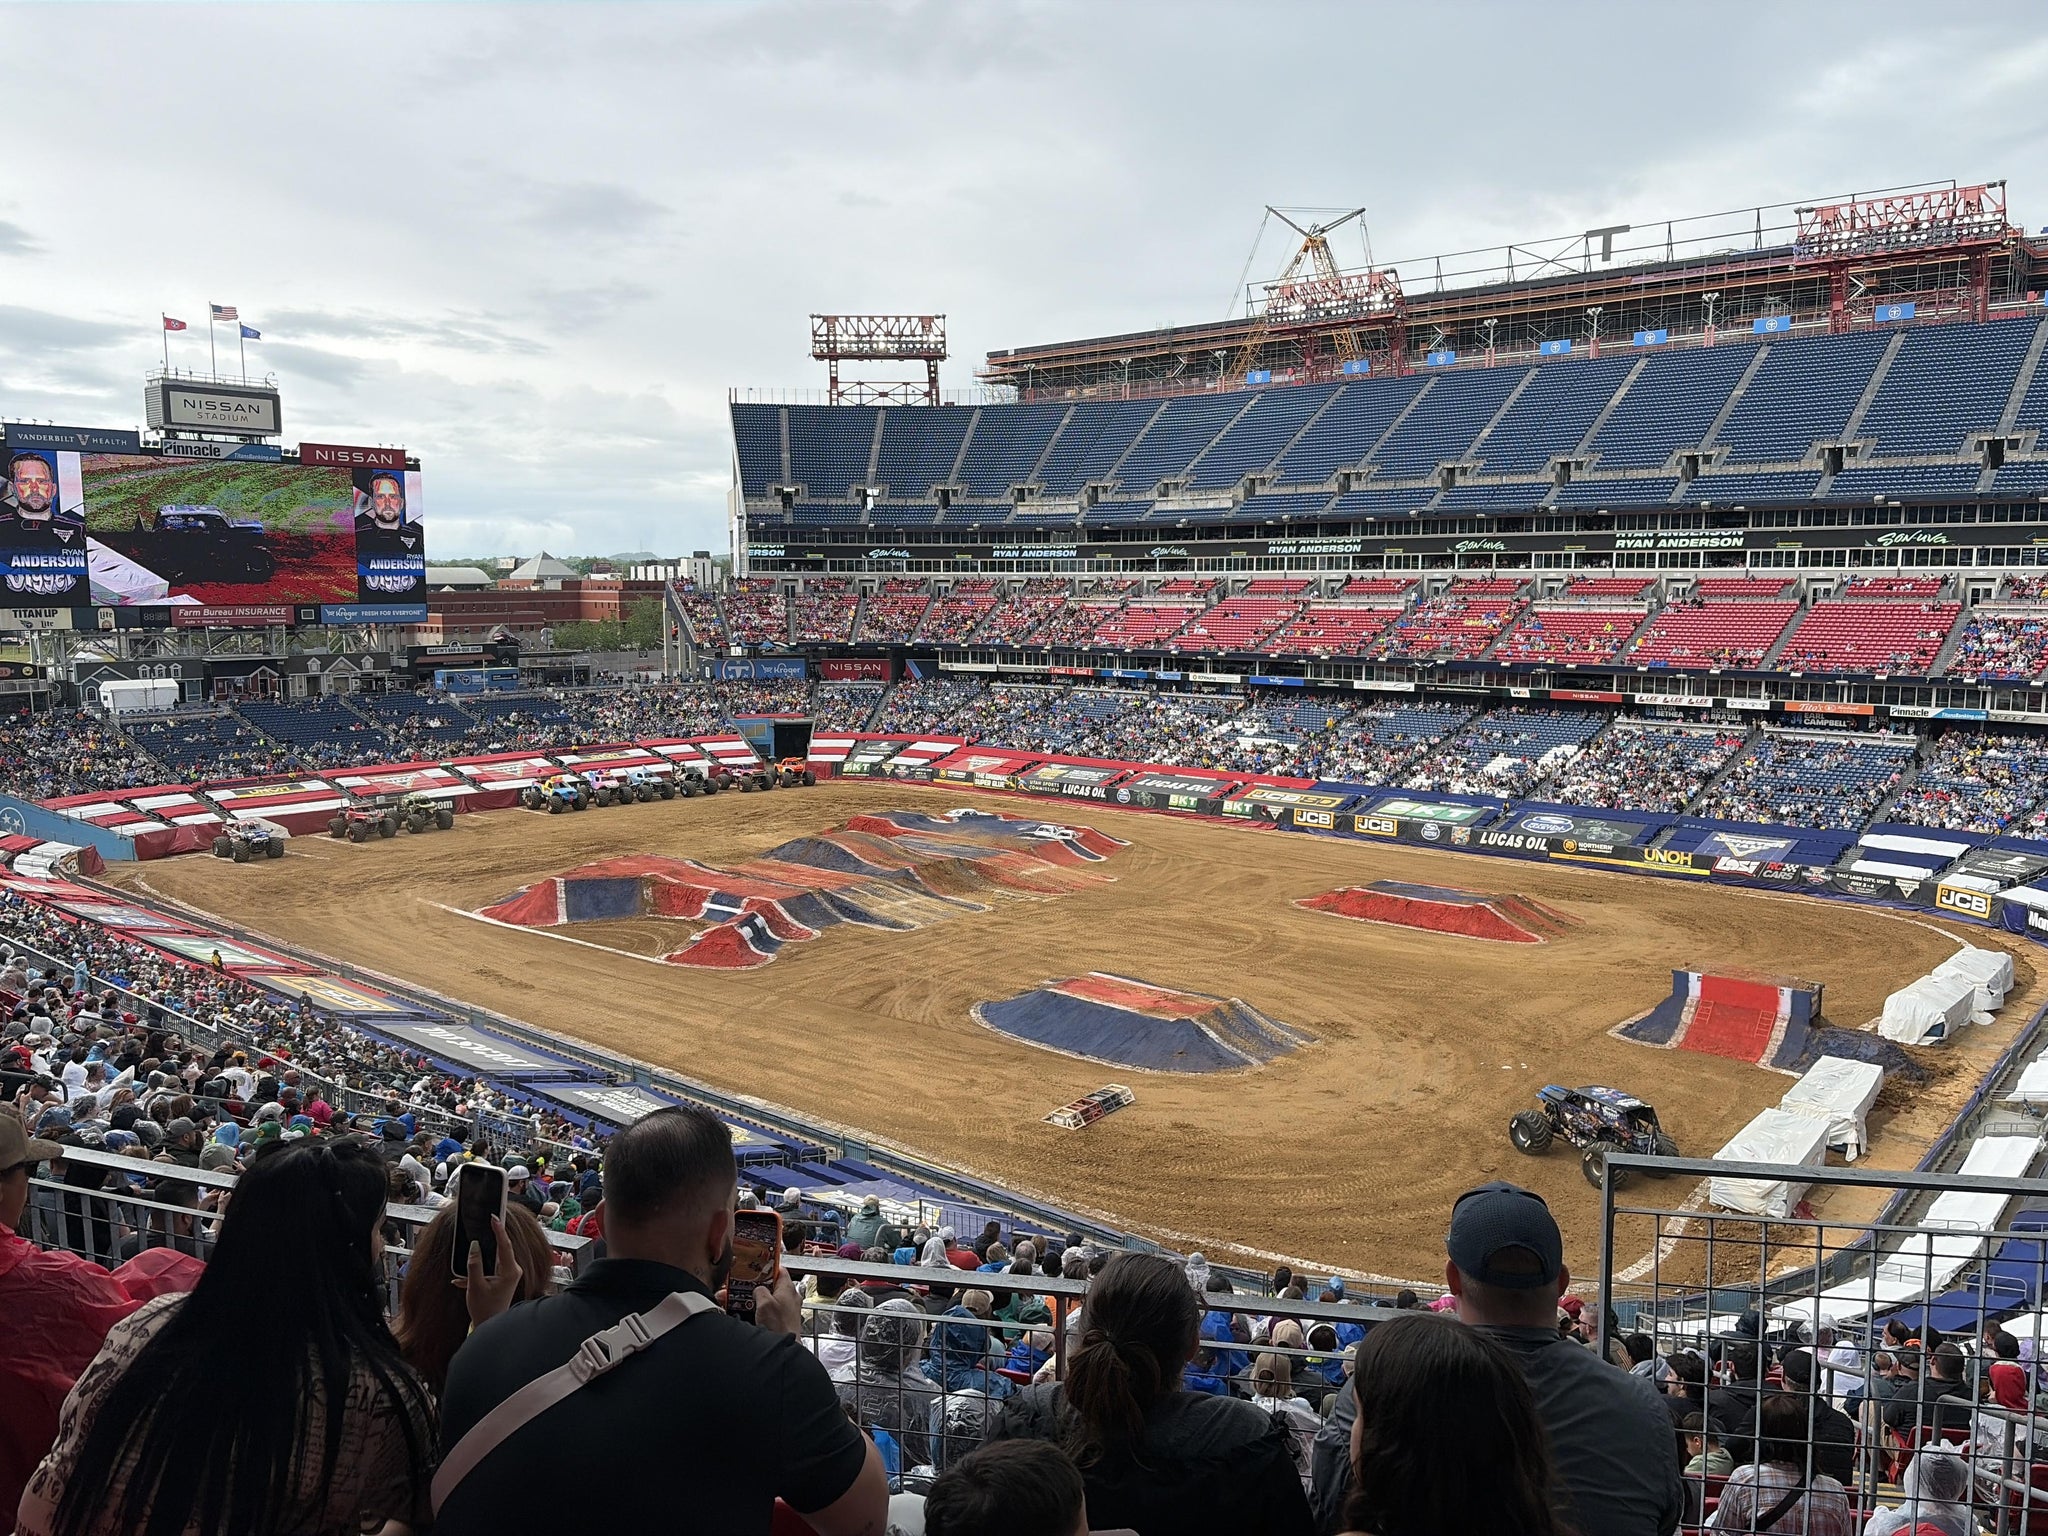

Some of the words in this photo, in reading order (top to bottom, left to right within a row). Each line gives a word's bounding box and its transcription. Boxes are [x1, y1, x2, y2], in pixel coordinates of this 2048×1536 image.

[184, 399, 260, 414] NISSAN
[197, 412, 249, 422] STADIUM
[18, 433, 75, 443] VANDERBILT
[92, 438, 127, 446] HEALTH
[164, 441, 221, 457] Pinnacle
[316, 450, 393, 464] NISSAN
[1615, 538, 1657, 548] RYAN
[1657, 537, 1745, 548] ANDERSON
[992, 549, 1018, 557] RYAN
[1021, 549, 1077, 557] ANDERSON
[1268, 545, 1296, 554] RYAN
[1298, 544, 1362, 554] ANDERSON
[11, 555, 85, 567] ANDERSON
[369, 559, 423, 570] ANDERSON
[12, 609, 42, 618] TITAN
[44, 609, 58, 617] UP
[100, 611, 113, 619] Lite
[178, 609, 201, 617] Farm
[203, 608, 233, 616] Bureau
[235, 607, 287, 616] INSURANCE
[335, 607, 358, 620] Kroger
[773, 662, 801, 676] Kroger
[830, 662, 881, 671] NISSAN
[1798, 703, 1824, 712] Tito's
[1892, 707, 1930, 717] Pinnacle
[1803, 719, 1848, 727] CAMPBELL
[974, 779, 991, 787] SUPER
[991, 780, 1005, 788] GLUE
[1062, 784, 1090, 797] LUCAS
[1091, 786, 1107, 798] OIL
[1169, 795, 1197, 806] BKT
[1223, 801, 1253, 813] BKT
[1296, 811, 1331, 825] JCB
[1357, 817, 1394, 832] JCB
[1479, 832, 1523, 848] LUCAS
[1525, 837, 1548, 851] OIL
[1578, 842, 1613, 850] NORTHERN
[1644, 848, 1692, 866] UNOH
[1766, 861, 1783, 871] RC
[1762, 870, 1795, 881] CARS
[1941, 889, 1987, 913] JCB
